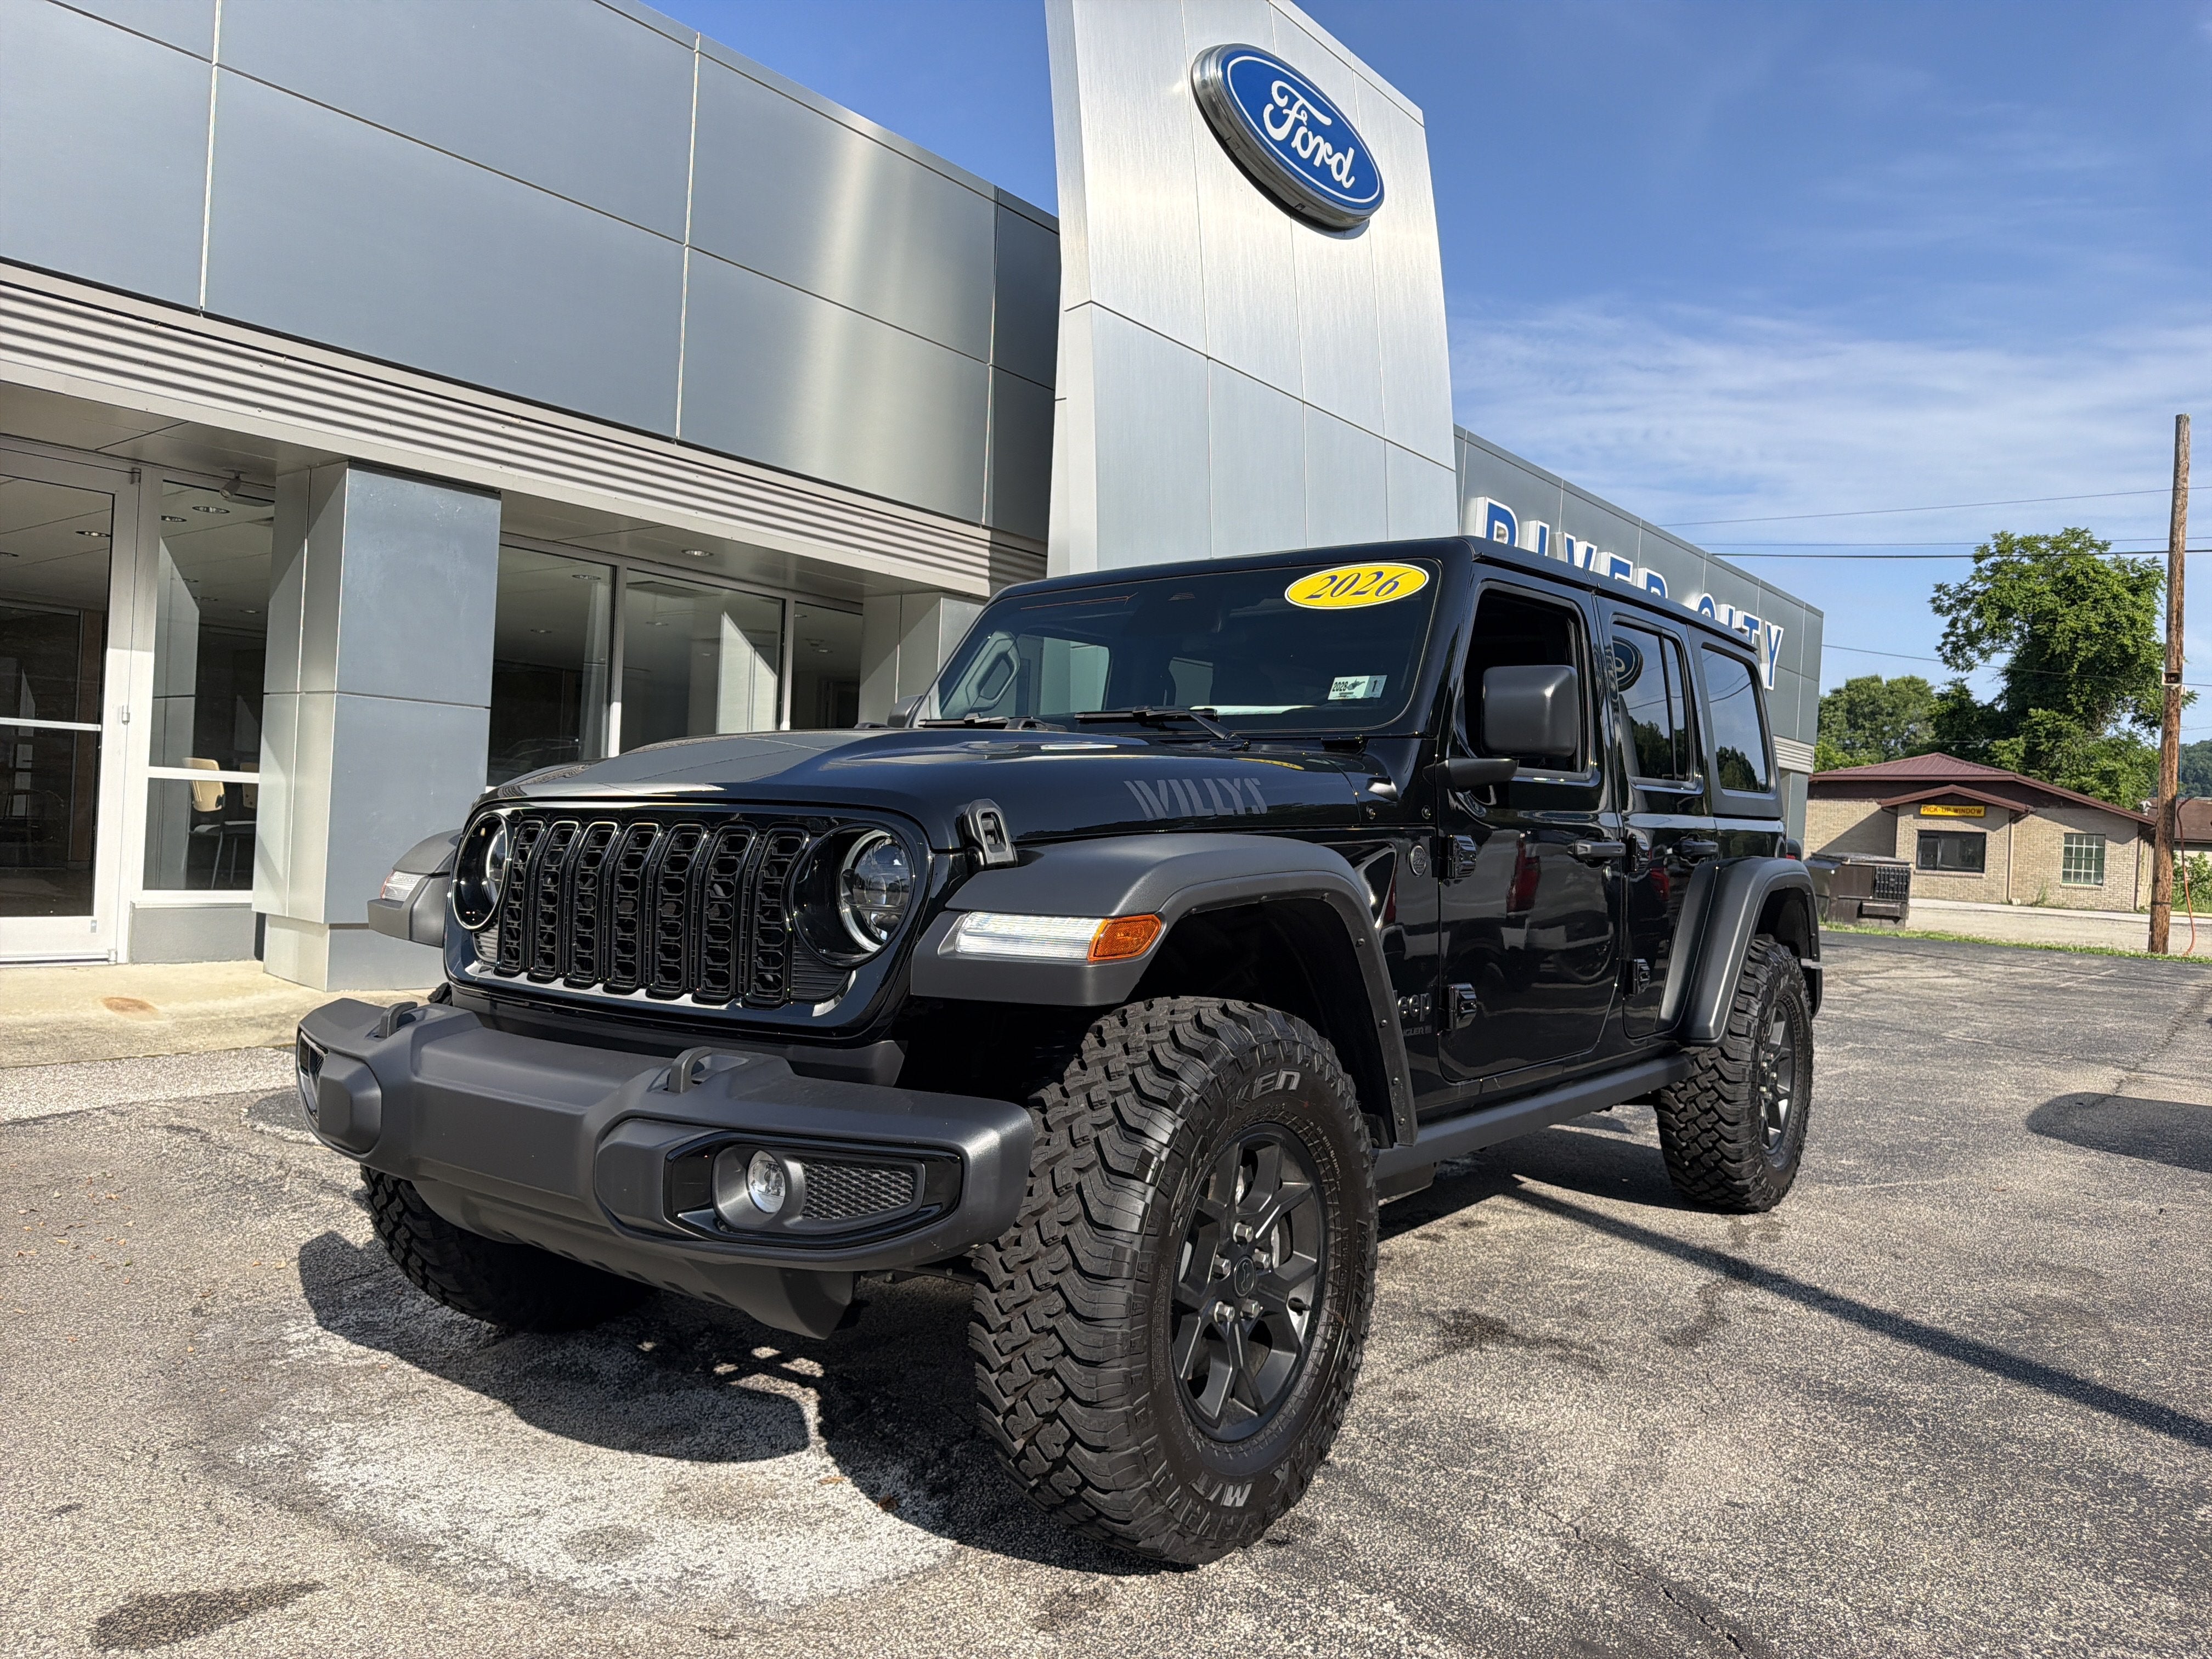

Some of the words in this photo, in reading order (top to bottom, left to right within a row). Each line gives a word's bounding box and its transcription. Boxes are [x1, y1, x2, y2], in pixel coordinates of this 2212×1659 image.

[1263, 80, 1355, 188] Ford
[1304, 571, 1412, 600] 2026
[1124, 778, 1268, 819] WILLYS
[1393, 989, 1432, 1022] eep
